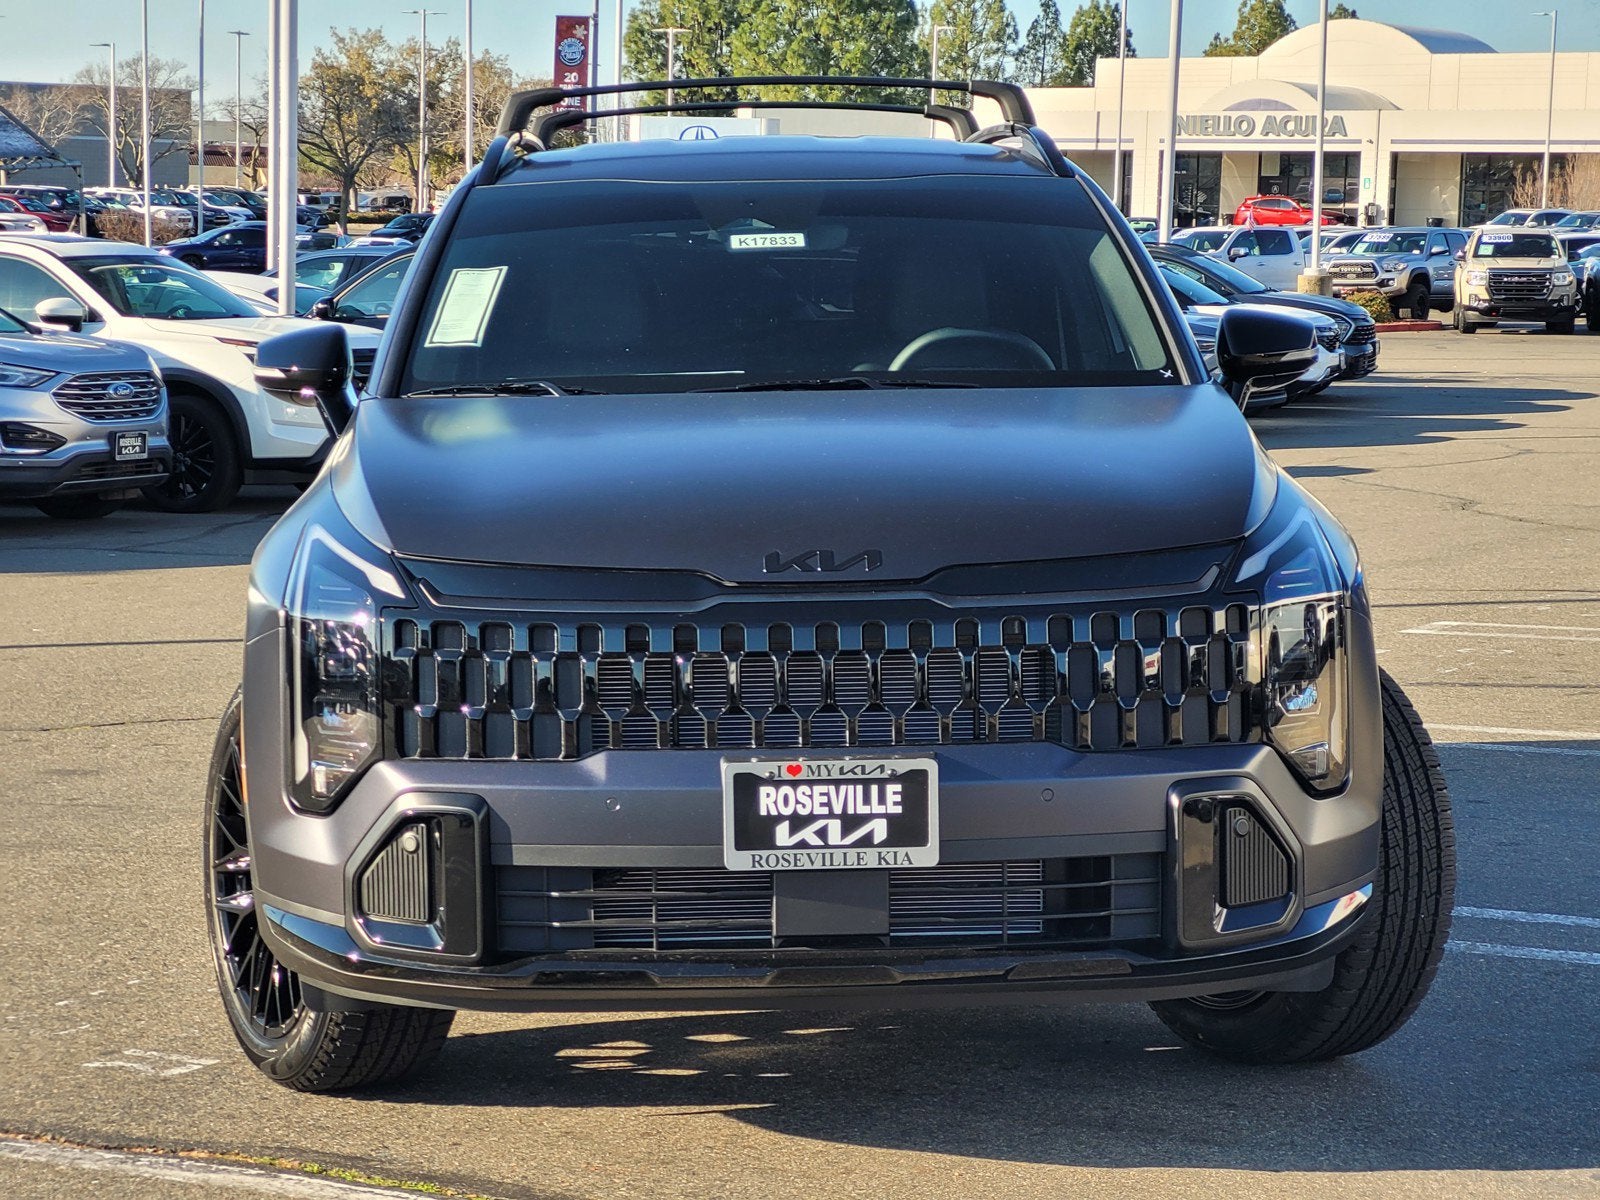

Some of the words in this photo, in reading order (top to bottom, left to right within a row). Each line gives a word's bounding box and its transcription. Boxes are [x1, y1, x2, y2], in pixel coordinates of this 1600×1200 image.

[563, 72, 579, 83] 20
[1260, 114, 1348, 137] ACURA
[738, 236, 798, 247] K17833
[116, 385, 130, 396] Ford
[121, 445, 141, 455] KIA
[763, 549, 883, 573] KIA
[806, 764, 836, 778] MY
[839, 763, 886, 776] KIA
[758, 783, 903, 816] ROSEVILLE
[775, 817, 888, 847] KIA
[750, 850, 868, 869] ROSEVILLE
[877, 850, 914, 866] KIA
